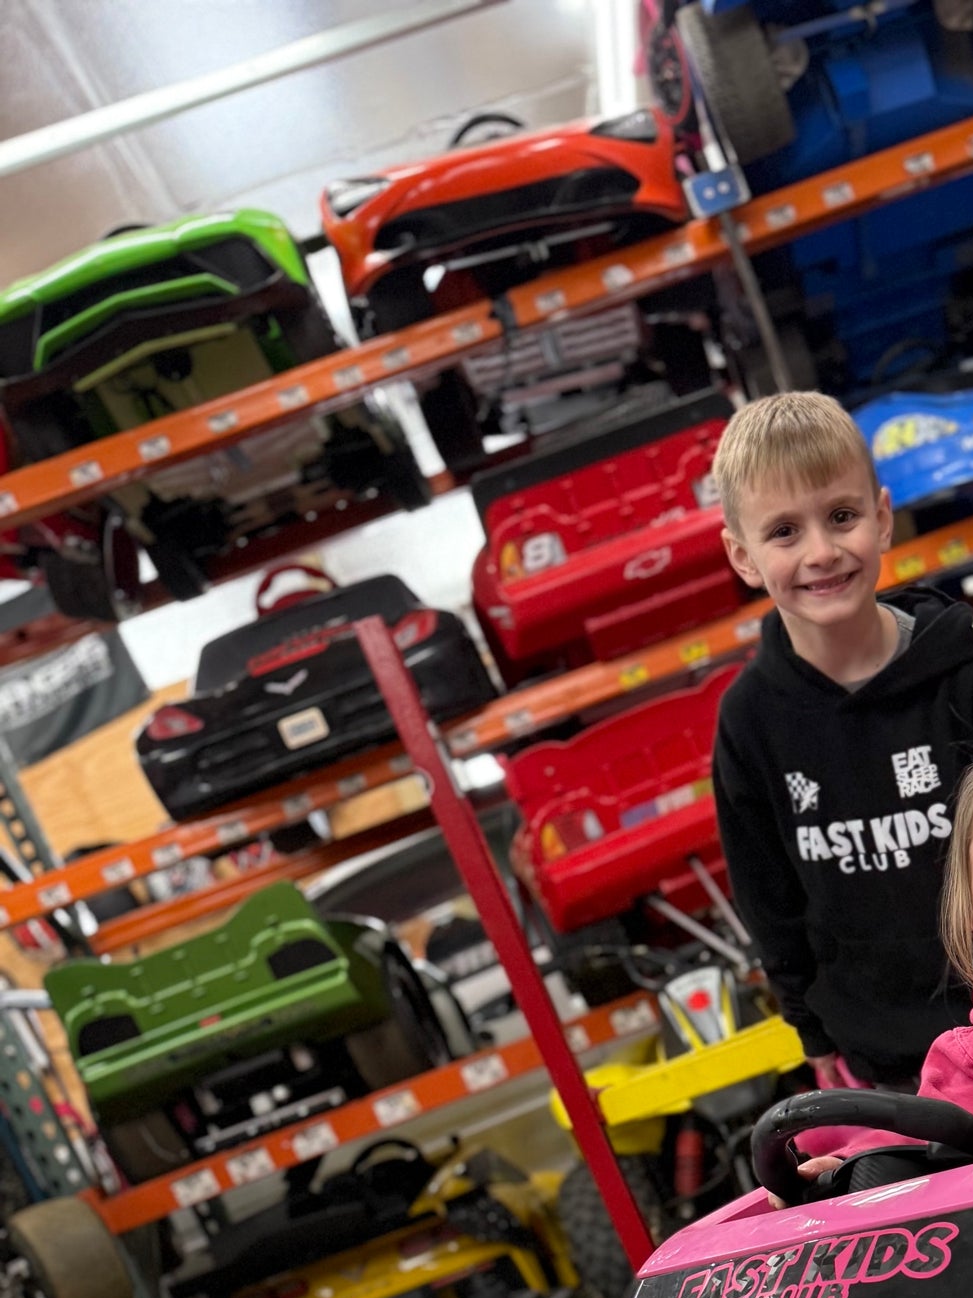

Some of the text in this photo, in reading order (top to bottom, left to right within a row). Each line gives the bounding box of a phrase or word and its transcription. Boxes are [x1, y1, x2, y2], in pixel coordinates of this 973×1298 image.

[891, 745, 932, 771] EAT
[896, 763, 939, 785] SLEEP
[897, 773, 942, 798] RACE
[796, 803, 952, 861] FAST KIDS
[839, 850, 911, 874] CLUB
[802, 1222, 960, 1285] KIDS
